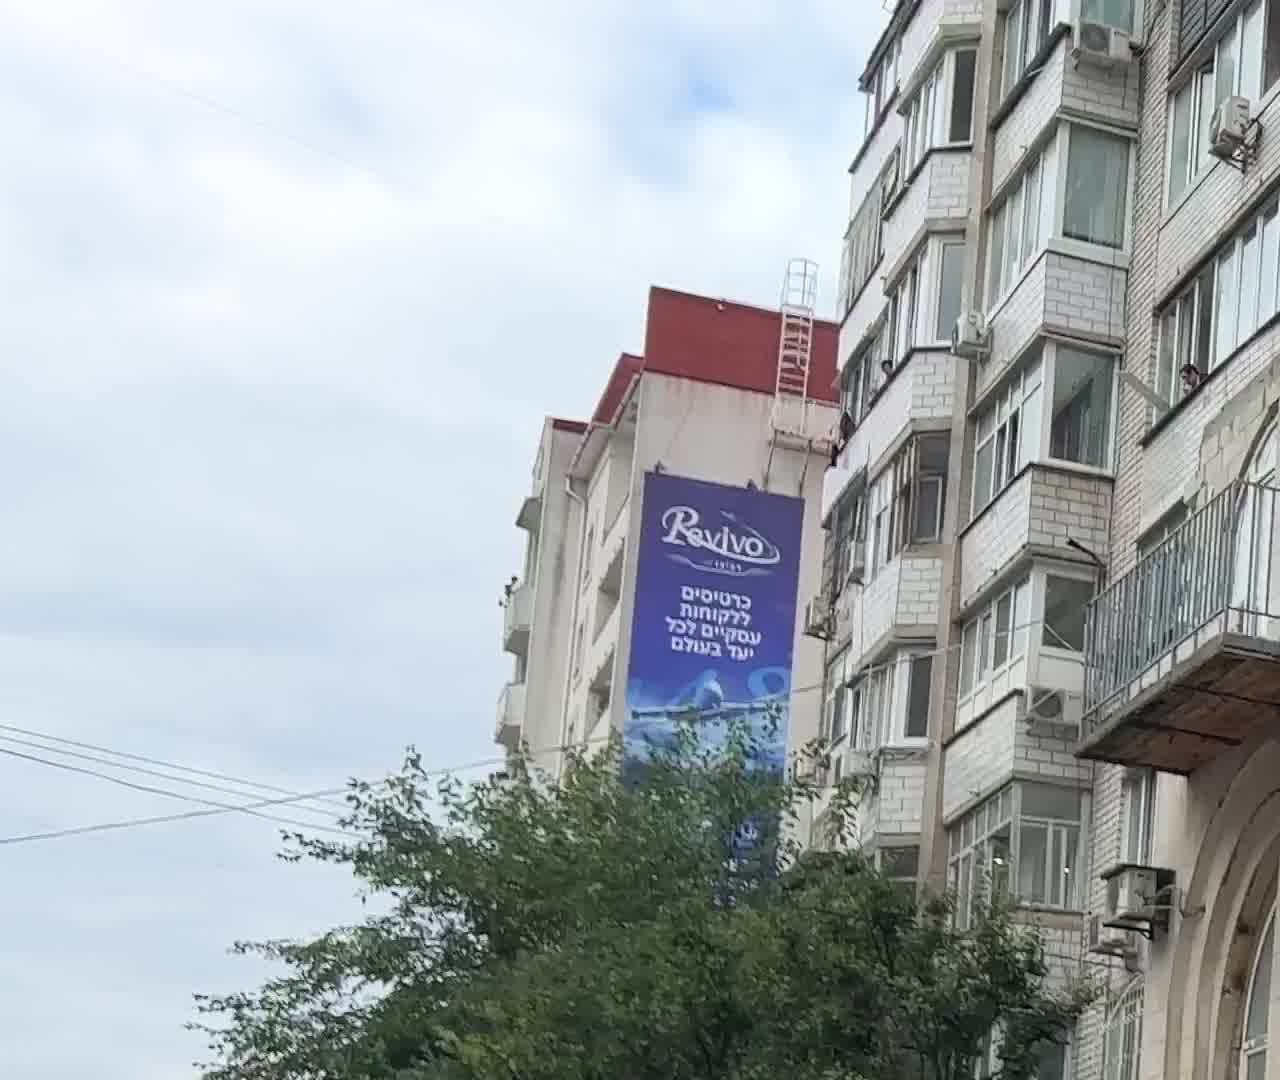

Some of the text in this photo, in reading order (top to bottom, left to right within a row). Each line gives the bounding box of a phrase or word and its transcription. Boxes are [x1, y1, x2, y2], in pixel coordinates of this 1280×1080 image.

[661, 505, 766, 558] Revivo
[680, 585, 752, 609] כרטיסים
[680, 602, 752, 627] ללקוחות
[727, 643, 755, 661] יעד
